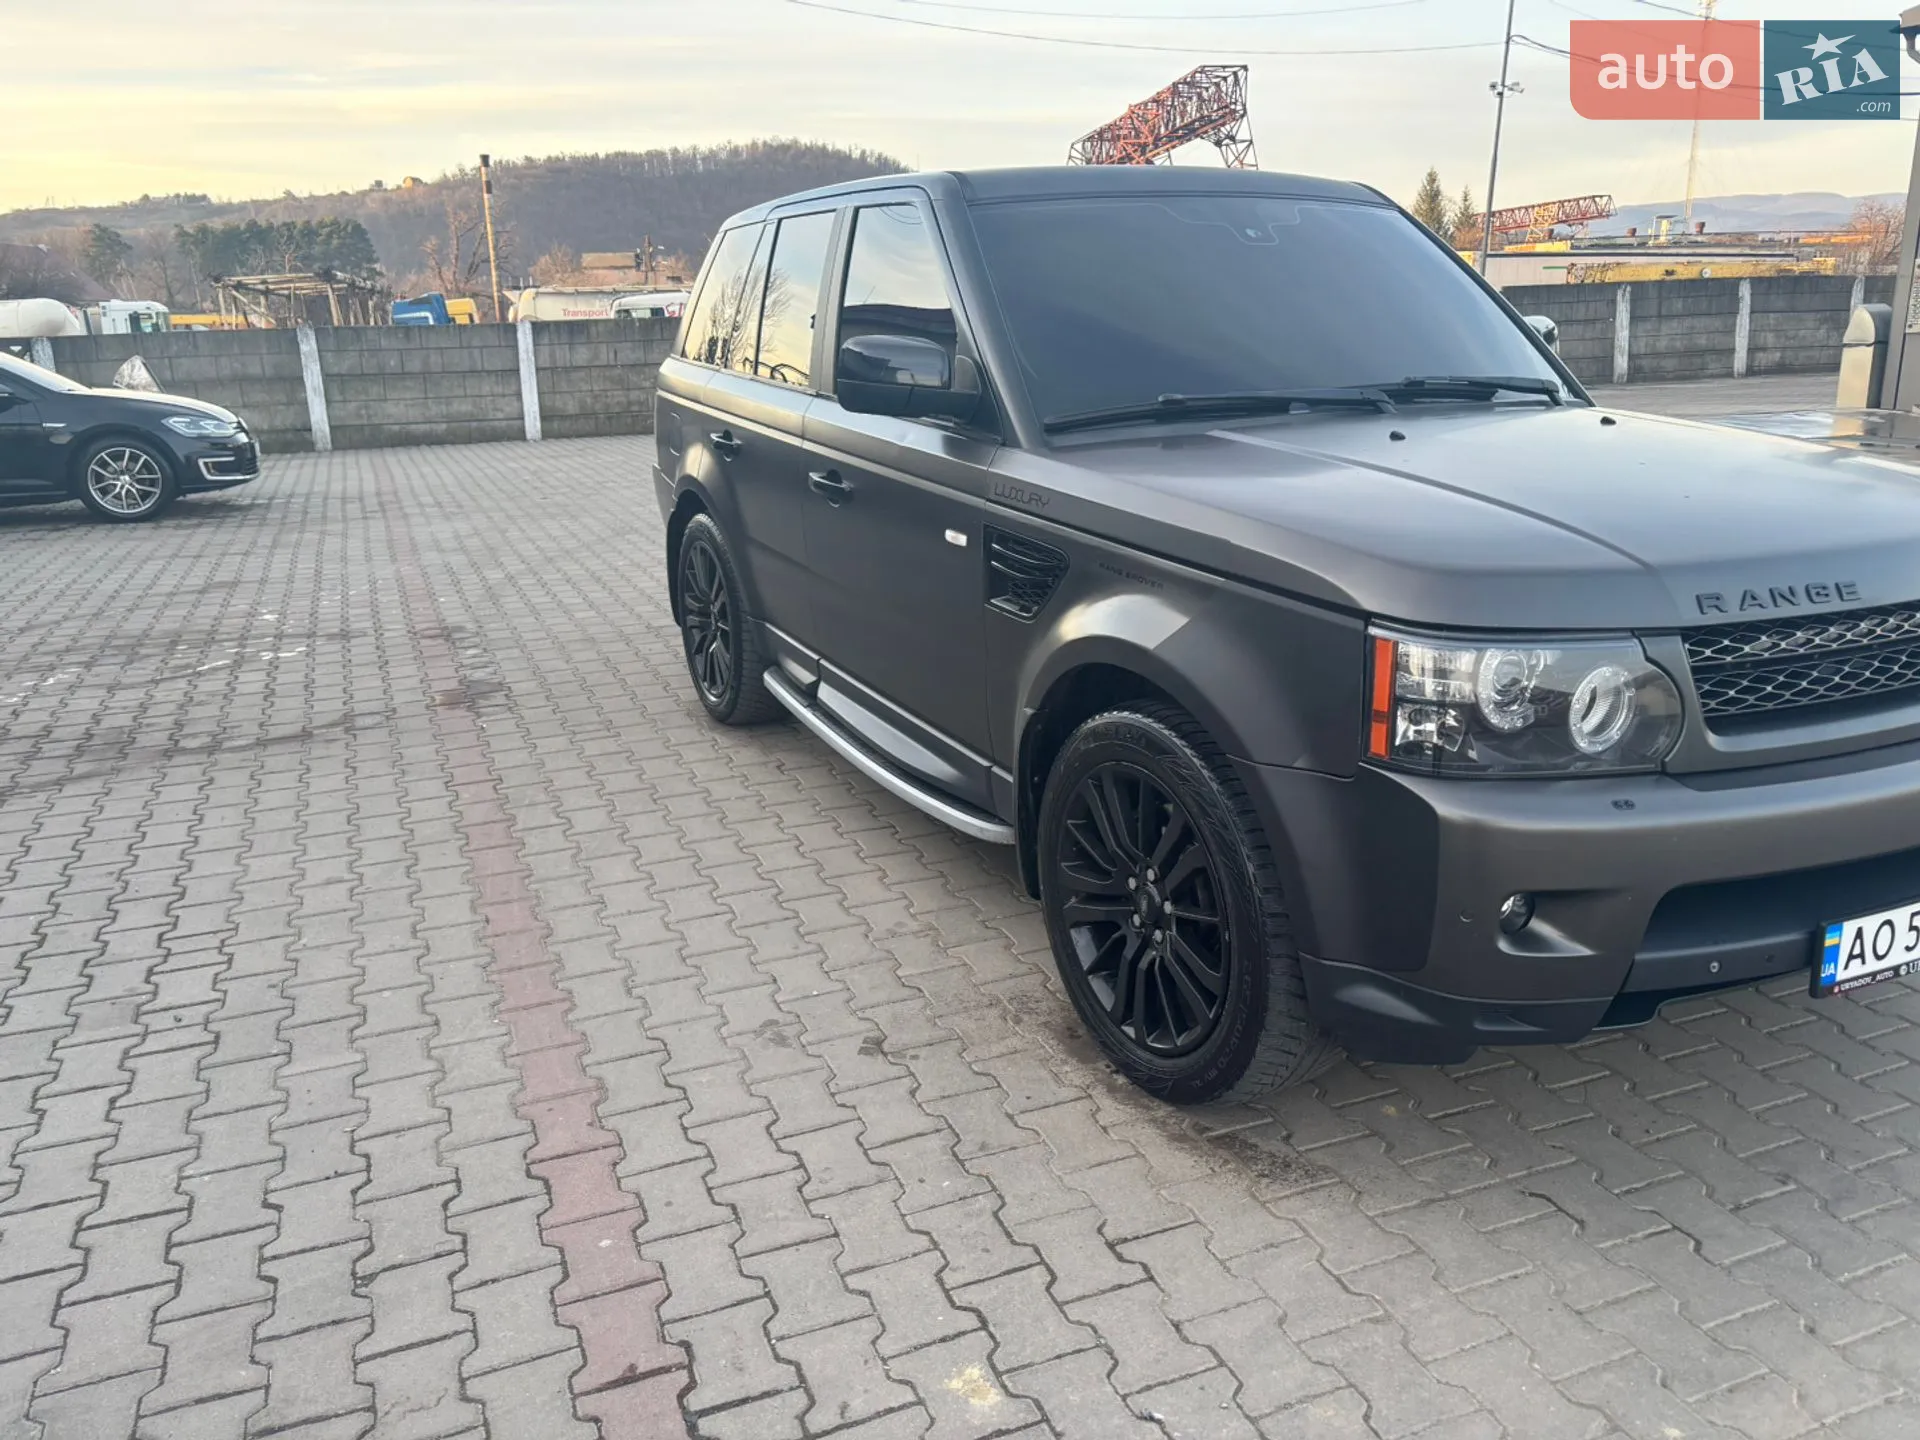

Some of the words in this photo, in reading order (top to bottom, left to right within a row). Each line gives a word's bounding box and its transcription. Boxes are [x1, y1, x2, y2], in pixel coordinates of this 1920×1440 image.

[562, 307, 609, 318] Transport
[994, 482, 1050, 509] LUXURY
[1695, 580, 1862, 616] RANGE
[1843, 919, 1896, 971] AO
[1821, 963, 1836, 978] UA
